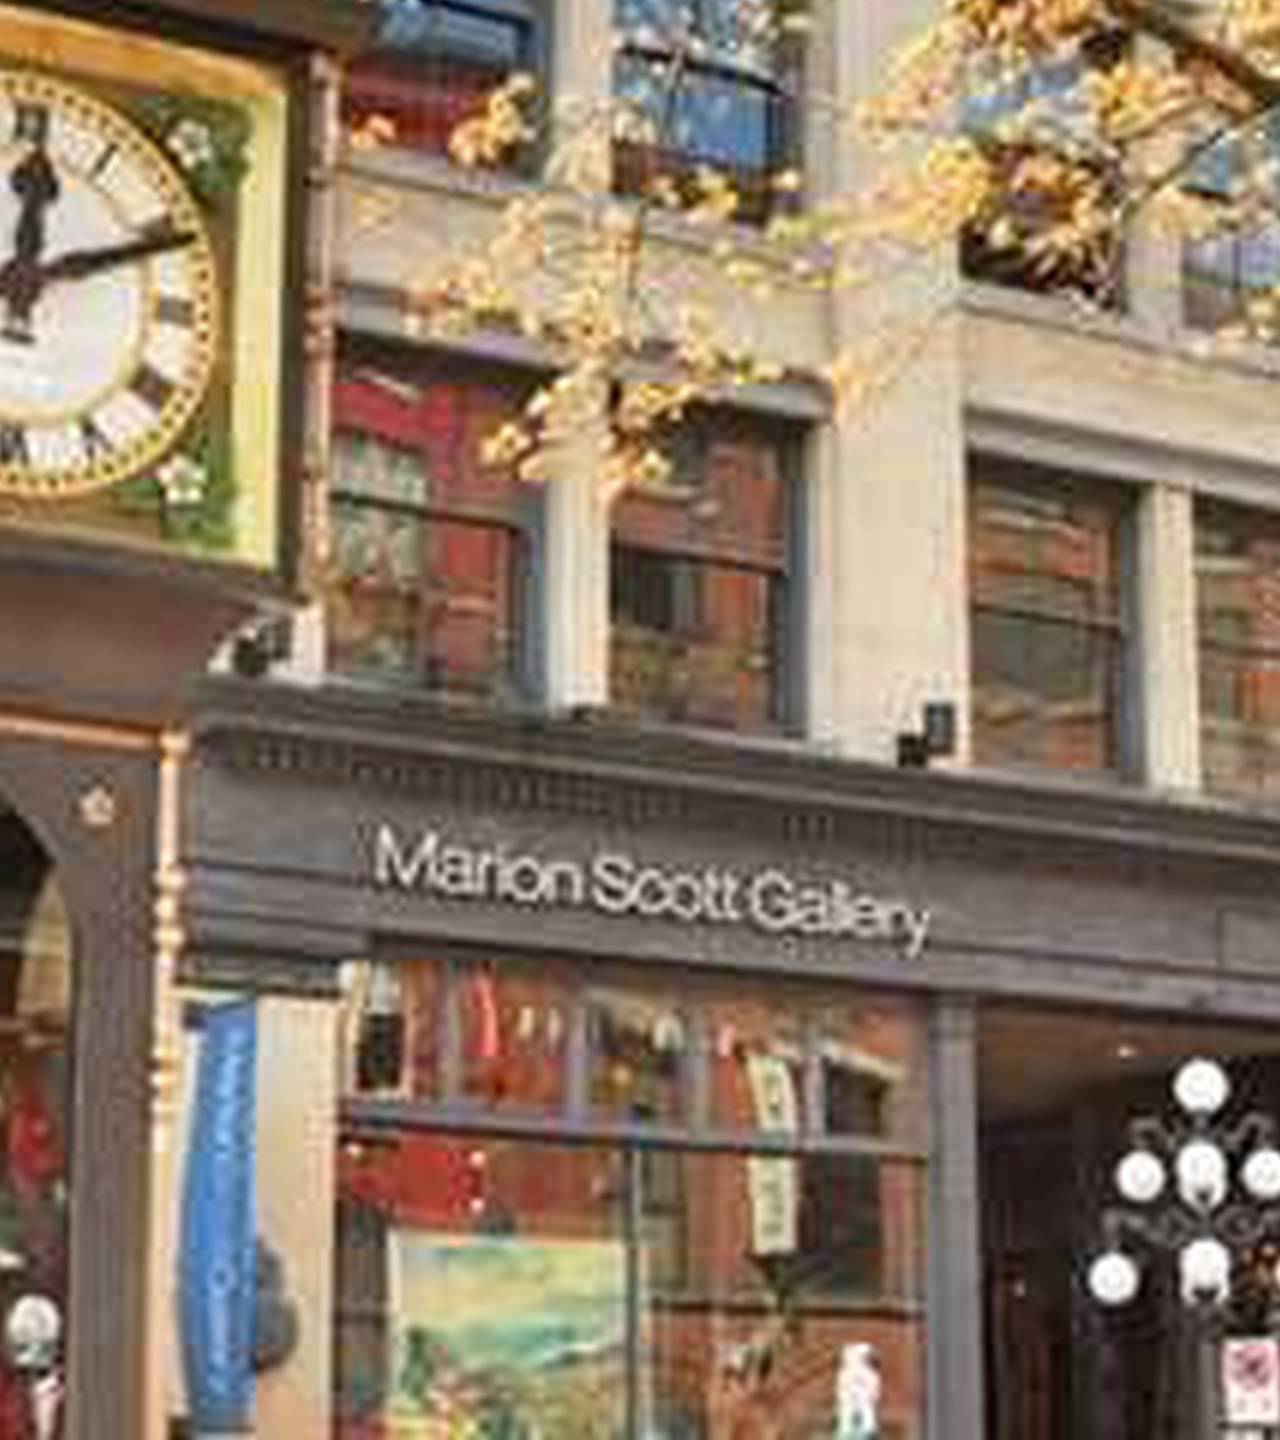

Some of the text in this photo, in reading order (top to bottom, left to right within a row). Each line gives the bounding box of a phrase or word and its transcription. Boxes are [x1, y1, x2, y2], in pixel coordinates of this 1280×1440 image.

[374, 824, 932, 958] Marion Scott Gallery
